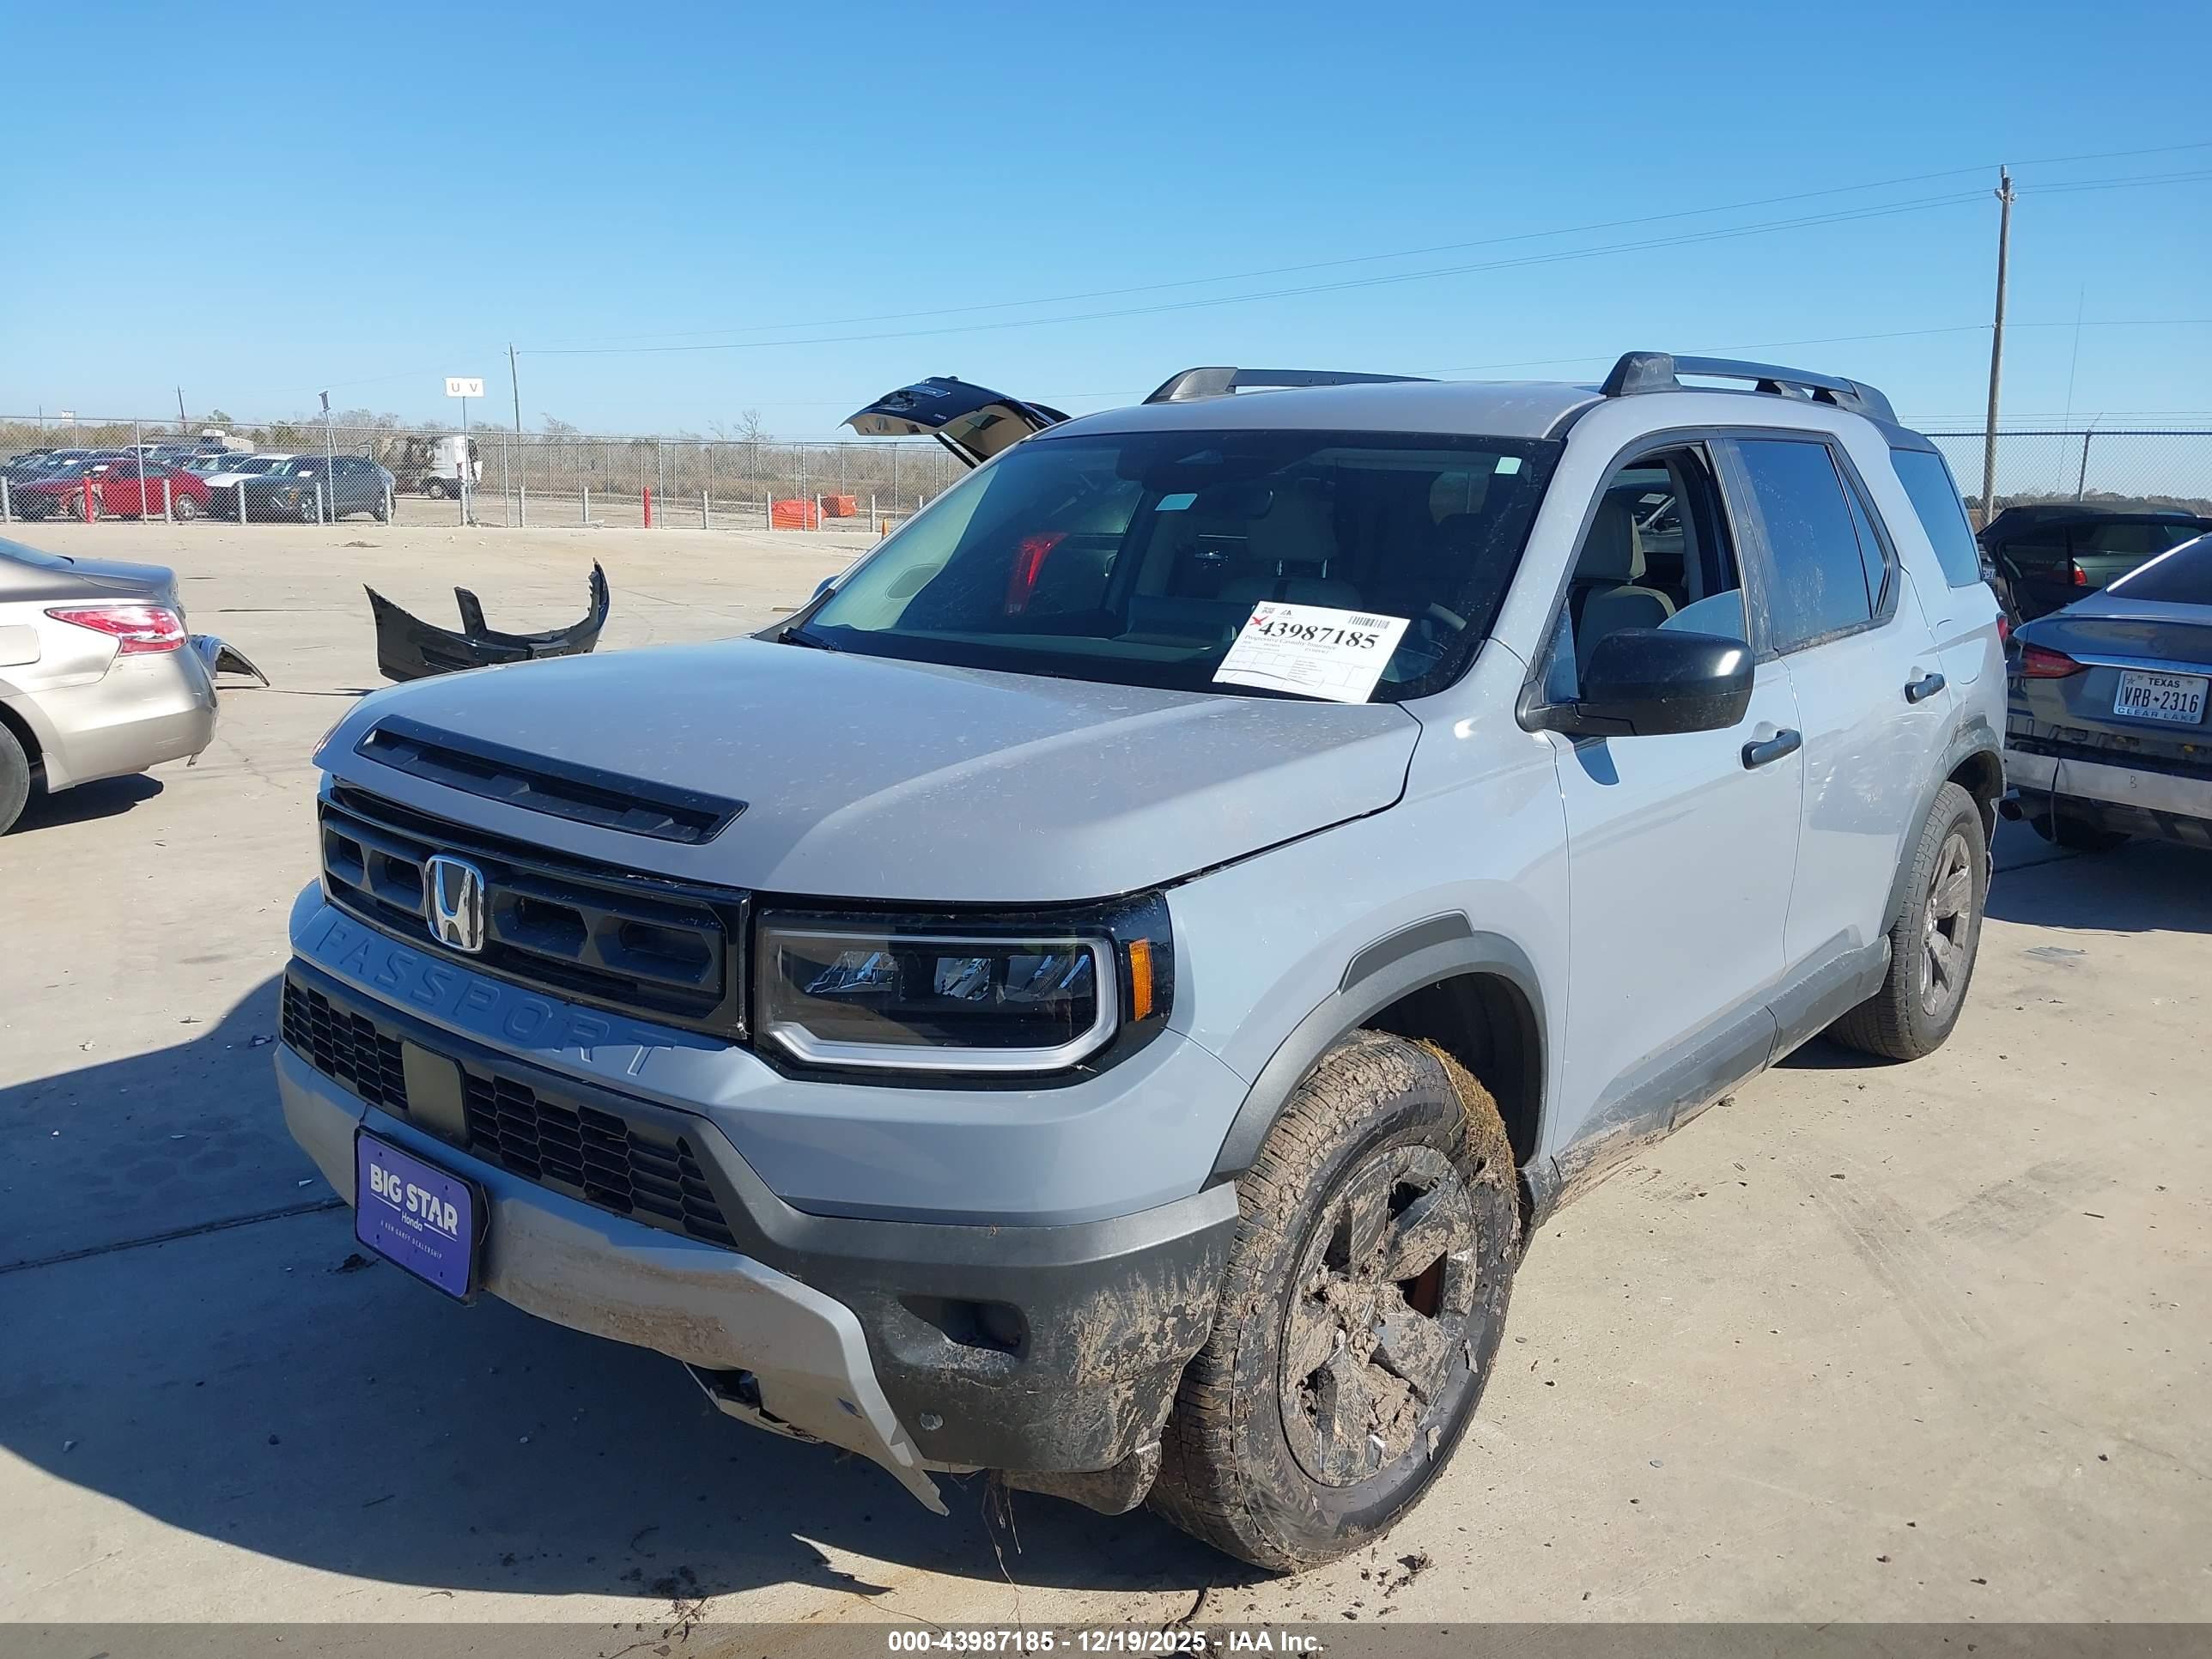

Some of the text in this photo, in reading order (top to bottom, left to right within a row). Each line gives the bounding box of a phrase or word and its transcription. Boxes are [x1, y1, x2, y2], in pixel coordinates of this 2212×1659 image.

[452, 383, 477, 392] U V
[1258, 621, 1380, 649] 43987185
[2148, 678, 2180, 688] TEXAS
[2118, 707, 2197, 722] CLEAR LAKE
[316, 921, 677, 1077] PASSPORT
[370, 1163, 458, 1236] BIG STAR
[401, 1211, 423, 1231] Honda
